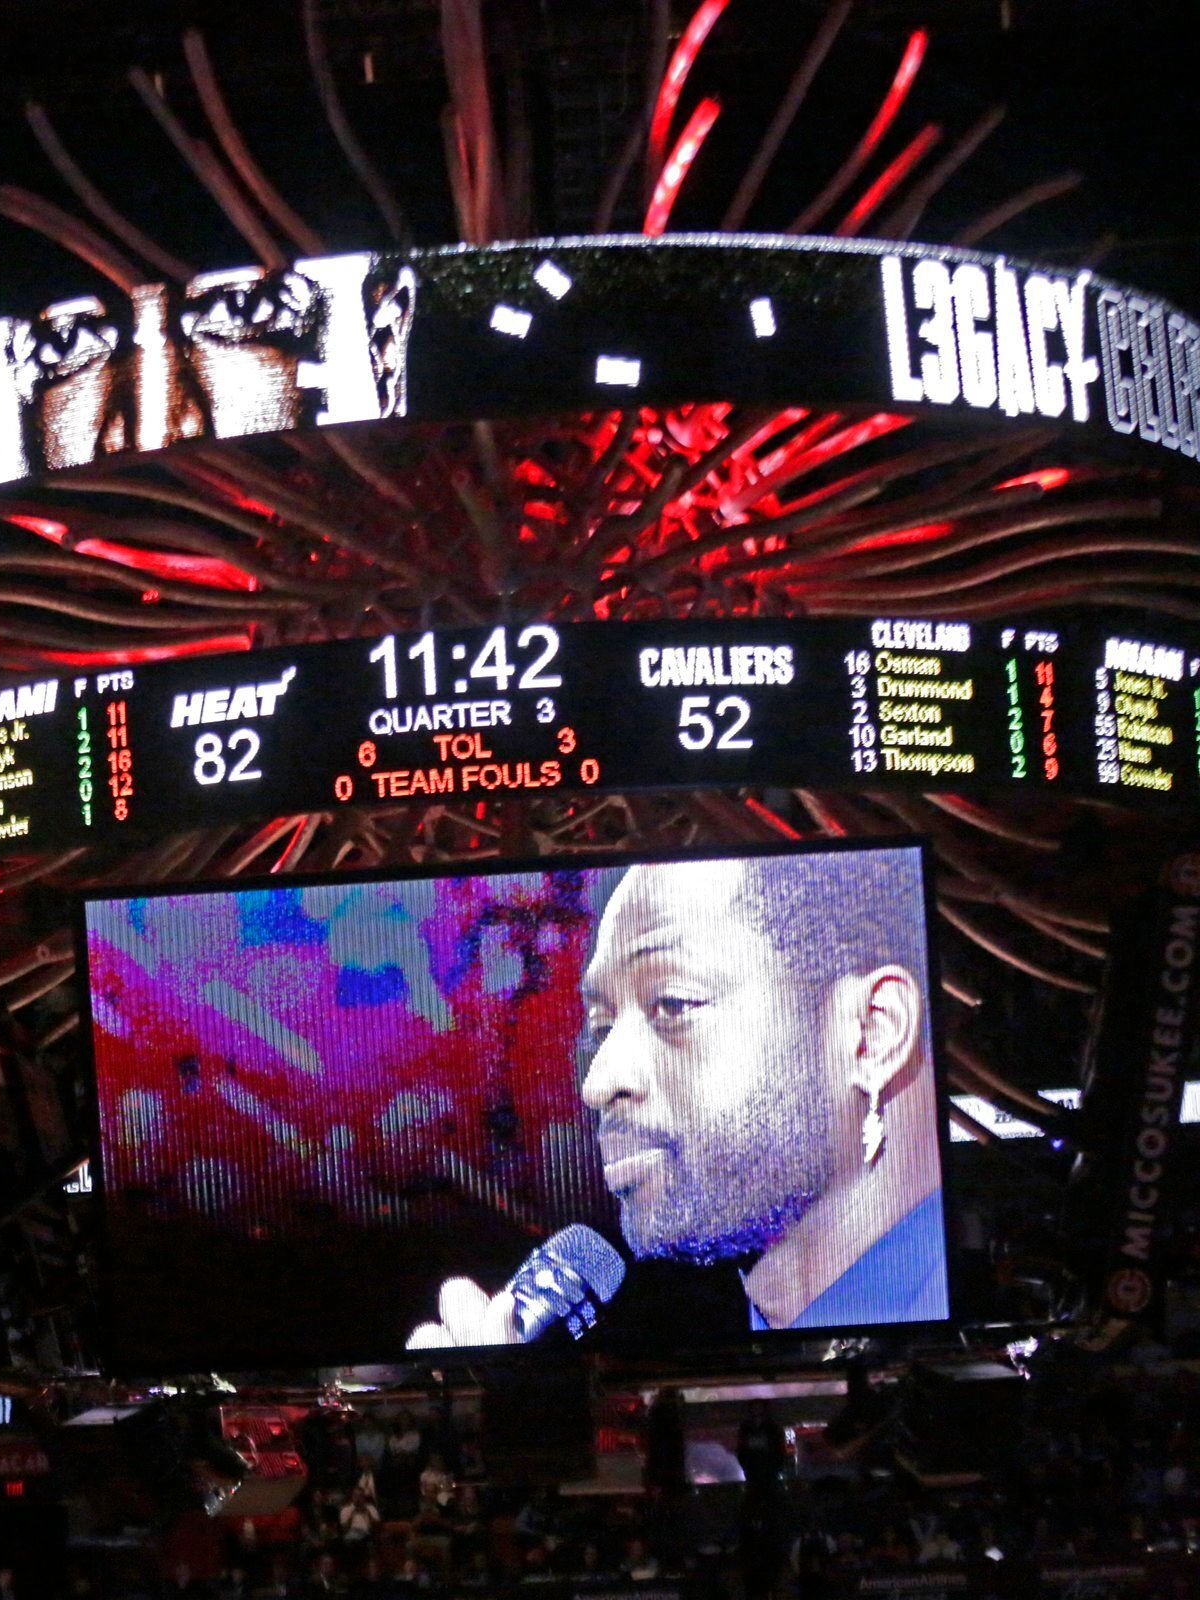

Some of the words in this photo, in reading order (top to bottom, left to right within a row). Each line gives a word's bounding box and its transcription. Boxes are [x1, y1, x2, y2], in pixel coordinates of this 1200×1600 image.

[368, 623, 564, 699] 11:42
[638, 645, 794, 688] CAVALIERS
[844, 650, 871, 676] 16
[1035, 660, 1055, 685] 11
[74, 678, 87, 698] F
[97, 670, 134, 694] PTS
[170, 666, 297, 728] HEAT
[877, 677, 973, 701] Drummond
[1040, 686, 1054, 709] 4
[77, 706, 88, 730] 1
[106, 700, 127, 726] 11
[369, 700, 512, 736] QUARTER
[535, 696, 556, 725] 3
[677, 696, 754, 751] 52
[851, 701, 869, 724] 2
[1008, 707, 1022, 731] 2
[1040, 710, 1054, 733] 7
[78, 731, 91, 755] 2
[106, 725, 127, 749] 11
[357, 740, 378, 768] 6
[433, 733, 492, 762] TOL
[556, 727, 577, 755] 3
[848, 725, 875, 749] 10
[880, 725, 952, 747] Garland
[78, 755, 92, 779] 2
[107, 749, 132, 774] 16
[193, 729, 263, 787] 82
[851, 750, 877, 773] 13
[881, 749, 975, 776] Thompson
[1011, 755, 1027, 779] 2
[79, 779, 93, 803] 0
[108, 773, 133, 798] 12
[334, 775, 354, 801] 0
[371, 766, 455, 798] TEAM
[462, 761, 561, 792] FOULS
[580, 758, 599, 785] 0
[83, 803, 92, 826] 1
[113, 797, 128, 821] 8
